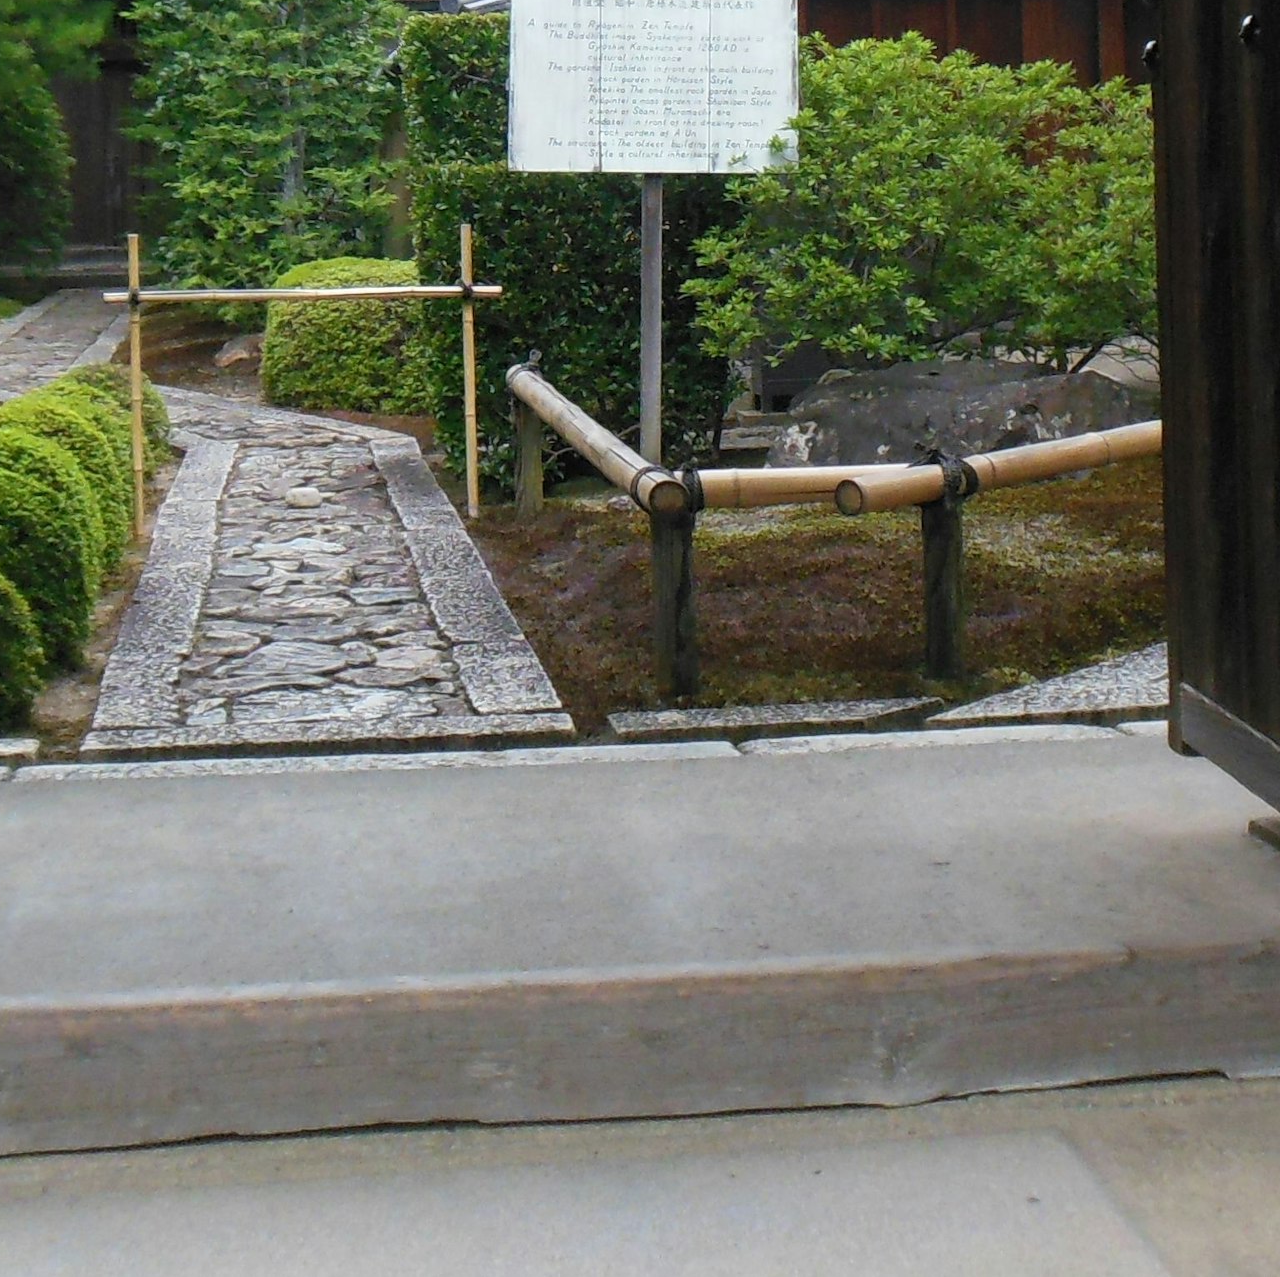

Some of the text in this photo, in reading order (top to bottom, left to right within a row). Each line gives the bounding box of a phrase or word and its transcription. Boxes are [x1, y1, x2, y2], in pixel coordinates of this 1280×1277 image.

[642, 21, 658, 29] Zen
[550, 30, 562, 39] The
[548, 62, 562, 71] The
[710, 76, 733, 84] Style
[631, 85, 643, 93] The
[548, 137, 562, 146] The
[726, 139, 740, 148] Zen
